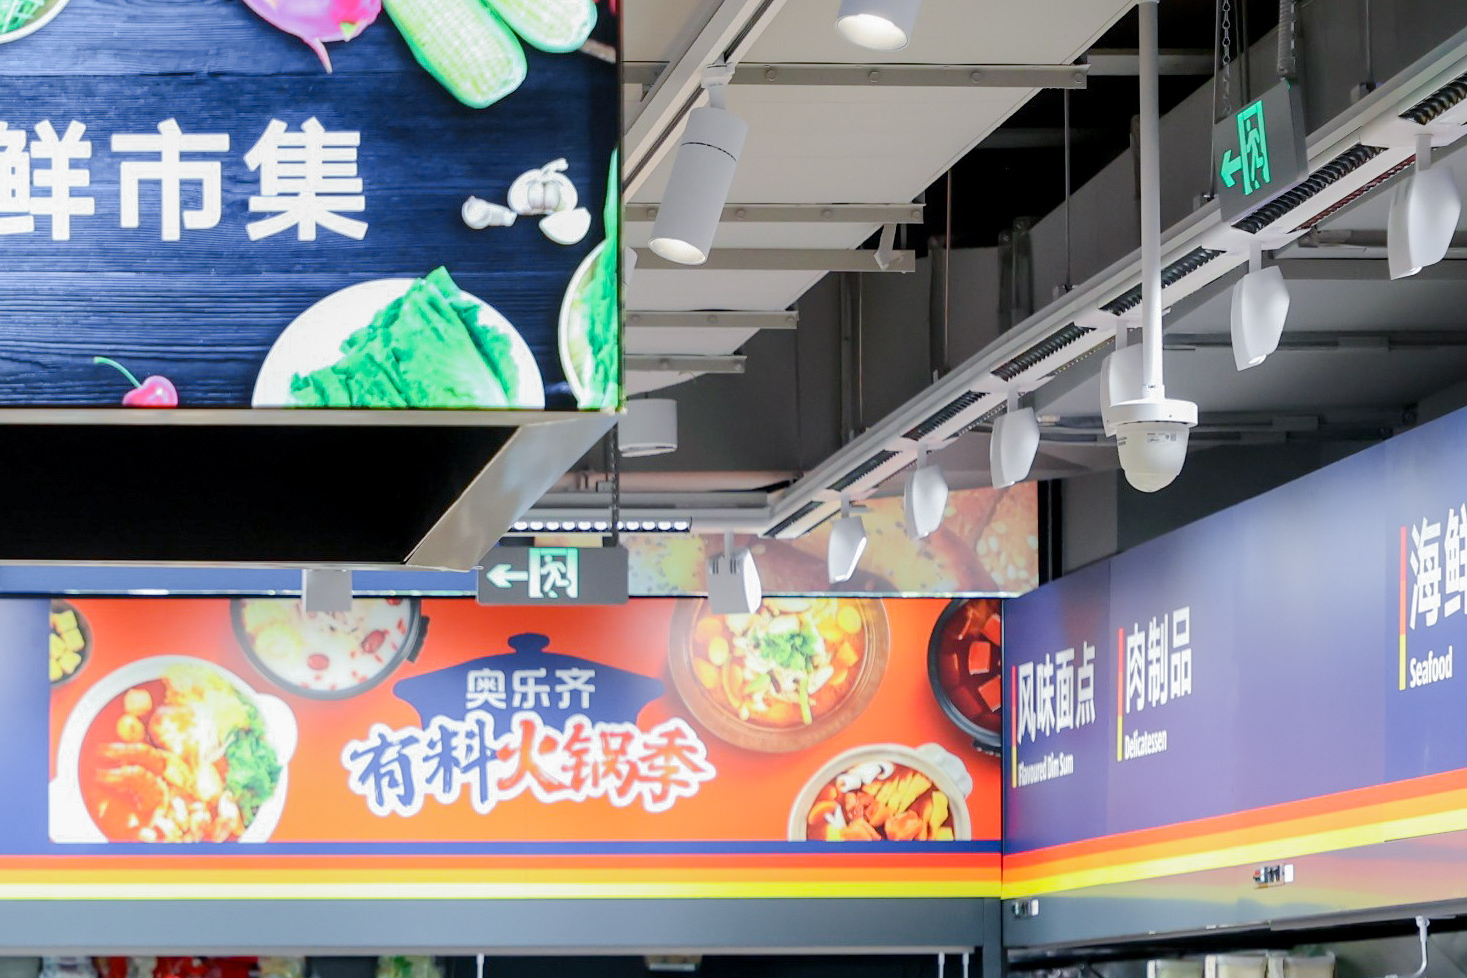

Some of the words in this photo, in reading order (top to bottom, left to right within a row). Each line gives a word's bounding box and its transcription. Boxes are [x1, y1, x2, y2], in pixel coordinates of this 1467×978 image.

[1125, 606, 1192, 714] 肉制品
[1409, 645, 1453, 689] Seafood
[465, 667, 597, 710] 奥乐齐
[1017, 640, 1096, 746] 风味面点
[347, 717, 709, 808] 有料火锅季
[1124, 729, 1168, 761] Delicatessen
[1018, 754, 1047, 787] Flavoured
[1047, 751, 1060, 779] Dim
[1060, 751, 1074, 776] Sum
